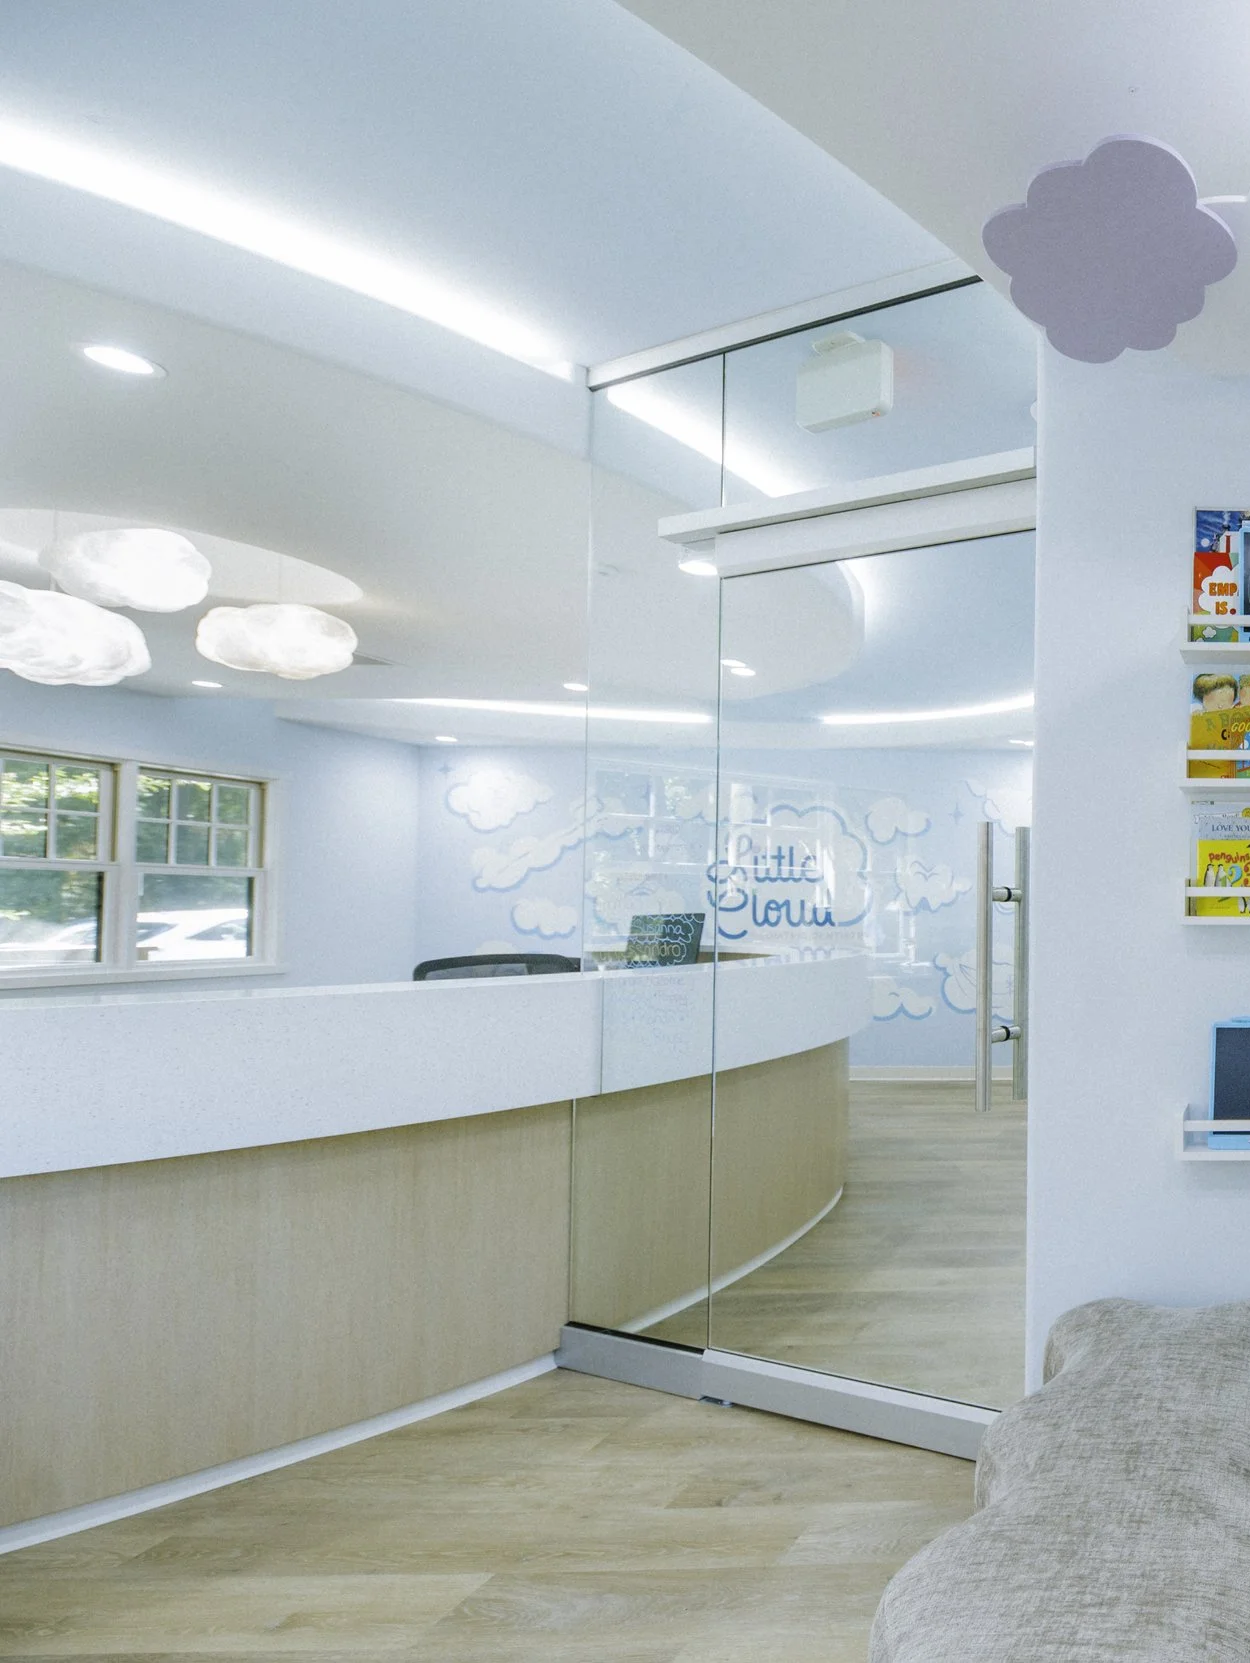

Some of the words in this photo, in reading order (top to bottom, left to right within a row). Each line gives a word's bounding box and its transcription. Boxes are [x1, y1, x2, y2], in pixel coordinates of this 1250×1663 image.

[1209, 583, 1239, 596] EMP
[1211, 824, 1234, 832] LOVE
[1208, 852, 1250, 865] penguins
